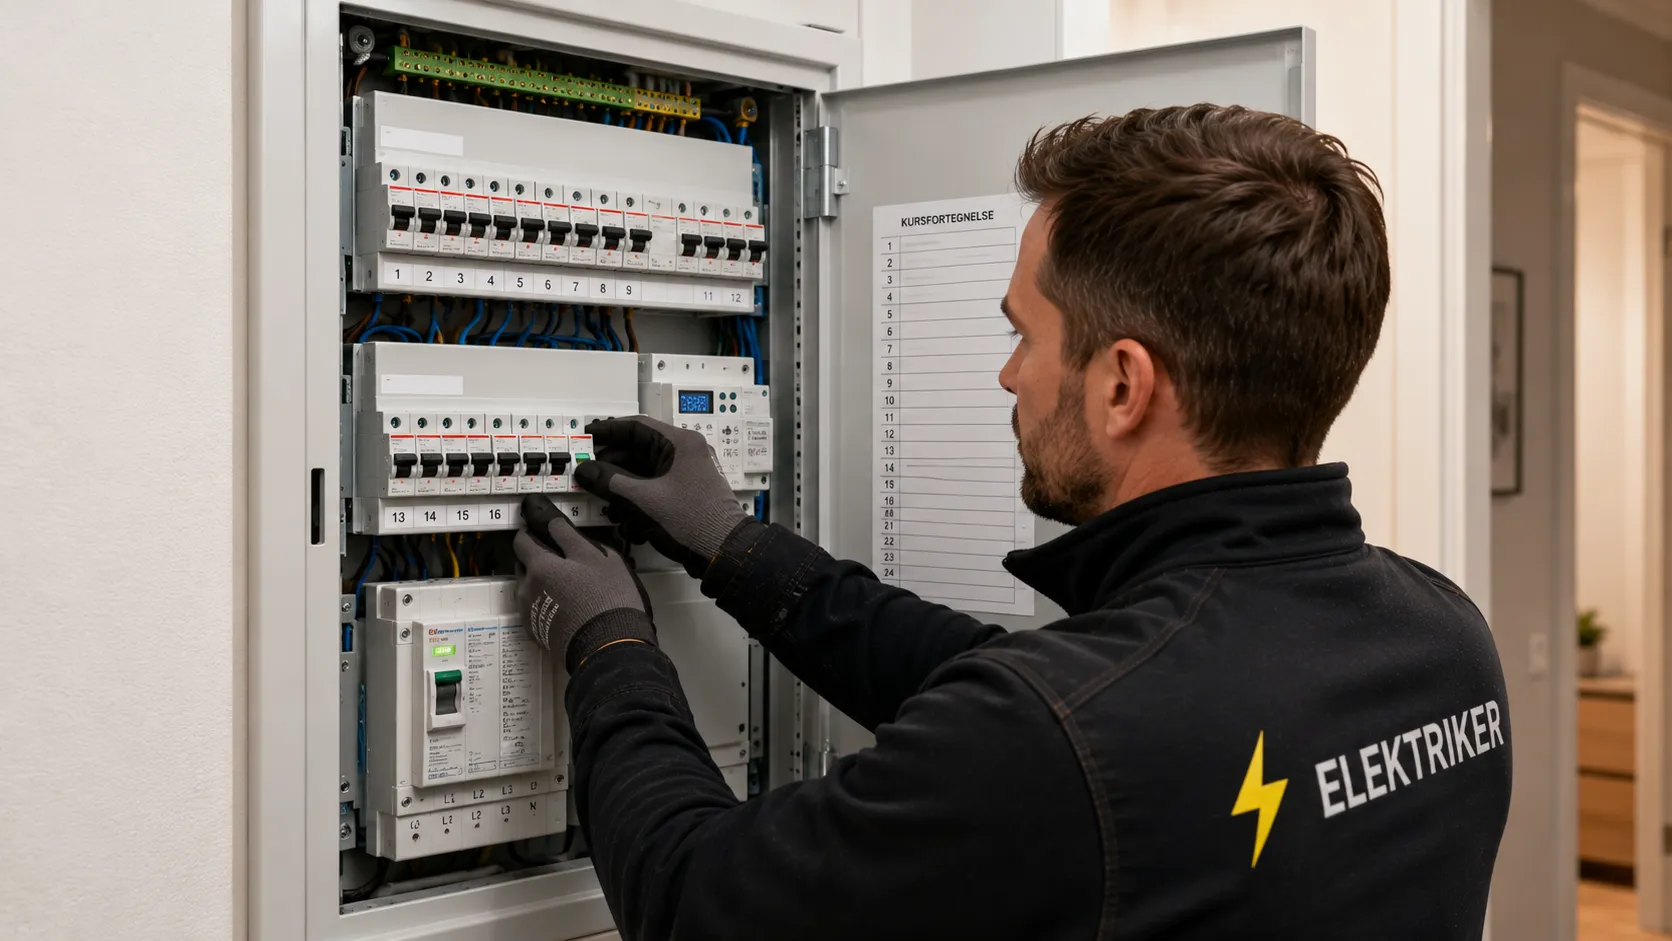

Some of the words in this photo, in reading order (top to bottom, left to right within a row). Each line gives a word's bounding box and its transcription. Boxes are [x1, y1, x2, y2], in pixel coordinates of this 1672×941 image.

[901, 210, 995, 227] KURSFORTEGNELSE
[887, 241, 892, 251] 1
[886, 257, 893, 268] 2
[887, 274, 893, 285] 3
[394, 268, 400, 280] 1
[425, 270, 433, 282] 2
[457, 272, 465, 284] 3
[486, 275, 495, 286] 4
[516, 276, 524, 289] 5
[544, 279, 552, 291] 6
[572, 281, 580, 292] 7
[599, 283, 607, 294] 8
[625, 284, 632, 296] 9
[703, 291, 713, 301] 11
[731, 293, 742, 303] 12
[886, 292, 893, 302] 4
[887, 309, 893, 320] 5
[886, 326, 893, 337] 6
[887, 343, 893, 354] 7
[886, 361, 893, 371] 8
[886, 378, 893, 389] 9
[884, 395, 895, 406] 10
[884, 412, 895, 424] 11
[884, 429, 895, 440] 12
[884, 445, 895, 456] 13
[884, 462, 895, 473] 14
[392, 511, 406, 524] 13
[423, 510, 437, 522] 14
[456, 509, 470, 521] 15
[488, 508, 502, 520] 16
[884, 520, 894, 530] 21
[883, 536, 895, 547] 22
[883, 551, 895, 562] 23
[884, 566, 895, 578] 24
[1315, 700, 1504, 818] ELEKTRIKER
[473, 788, 485, 800] L2
[502, 784, 514, 796] L3
